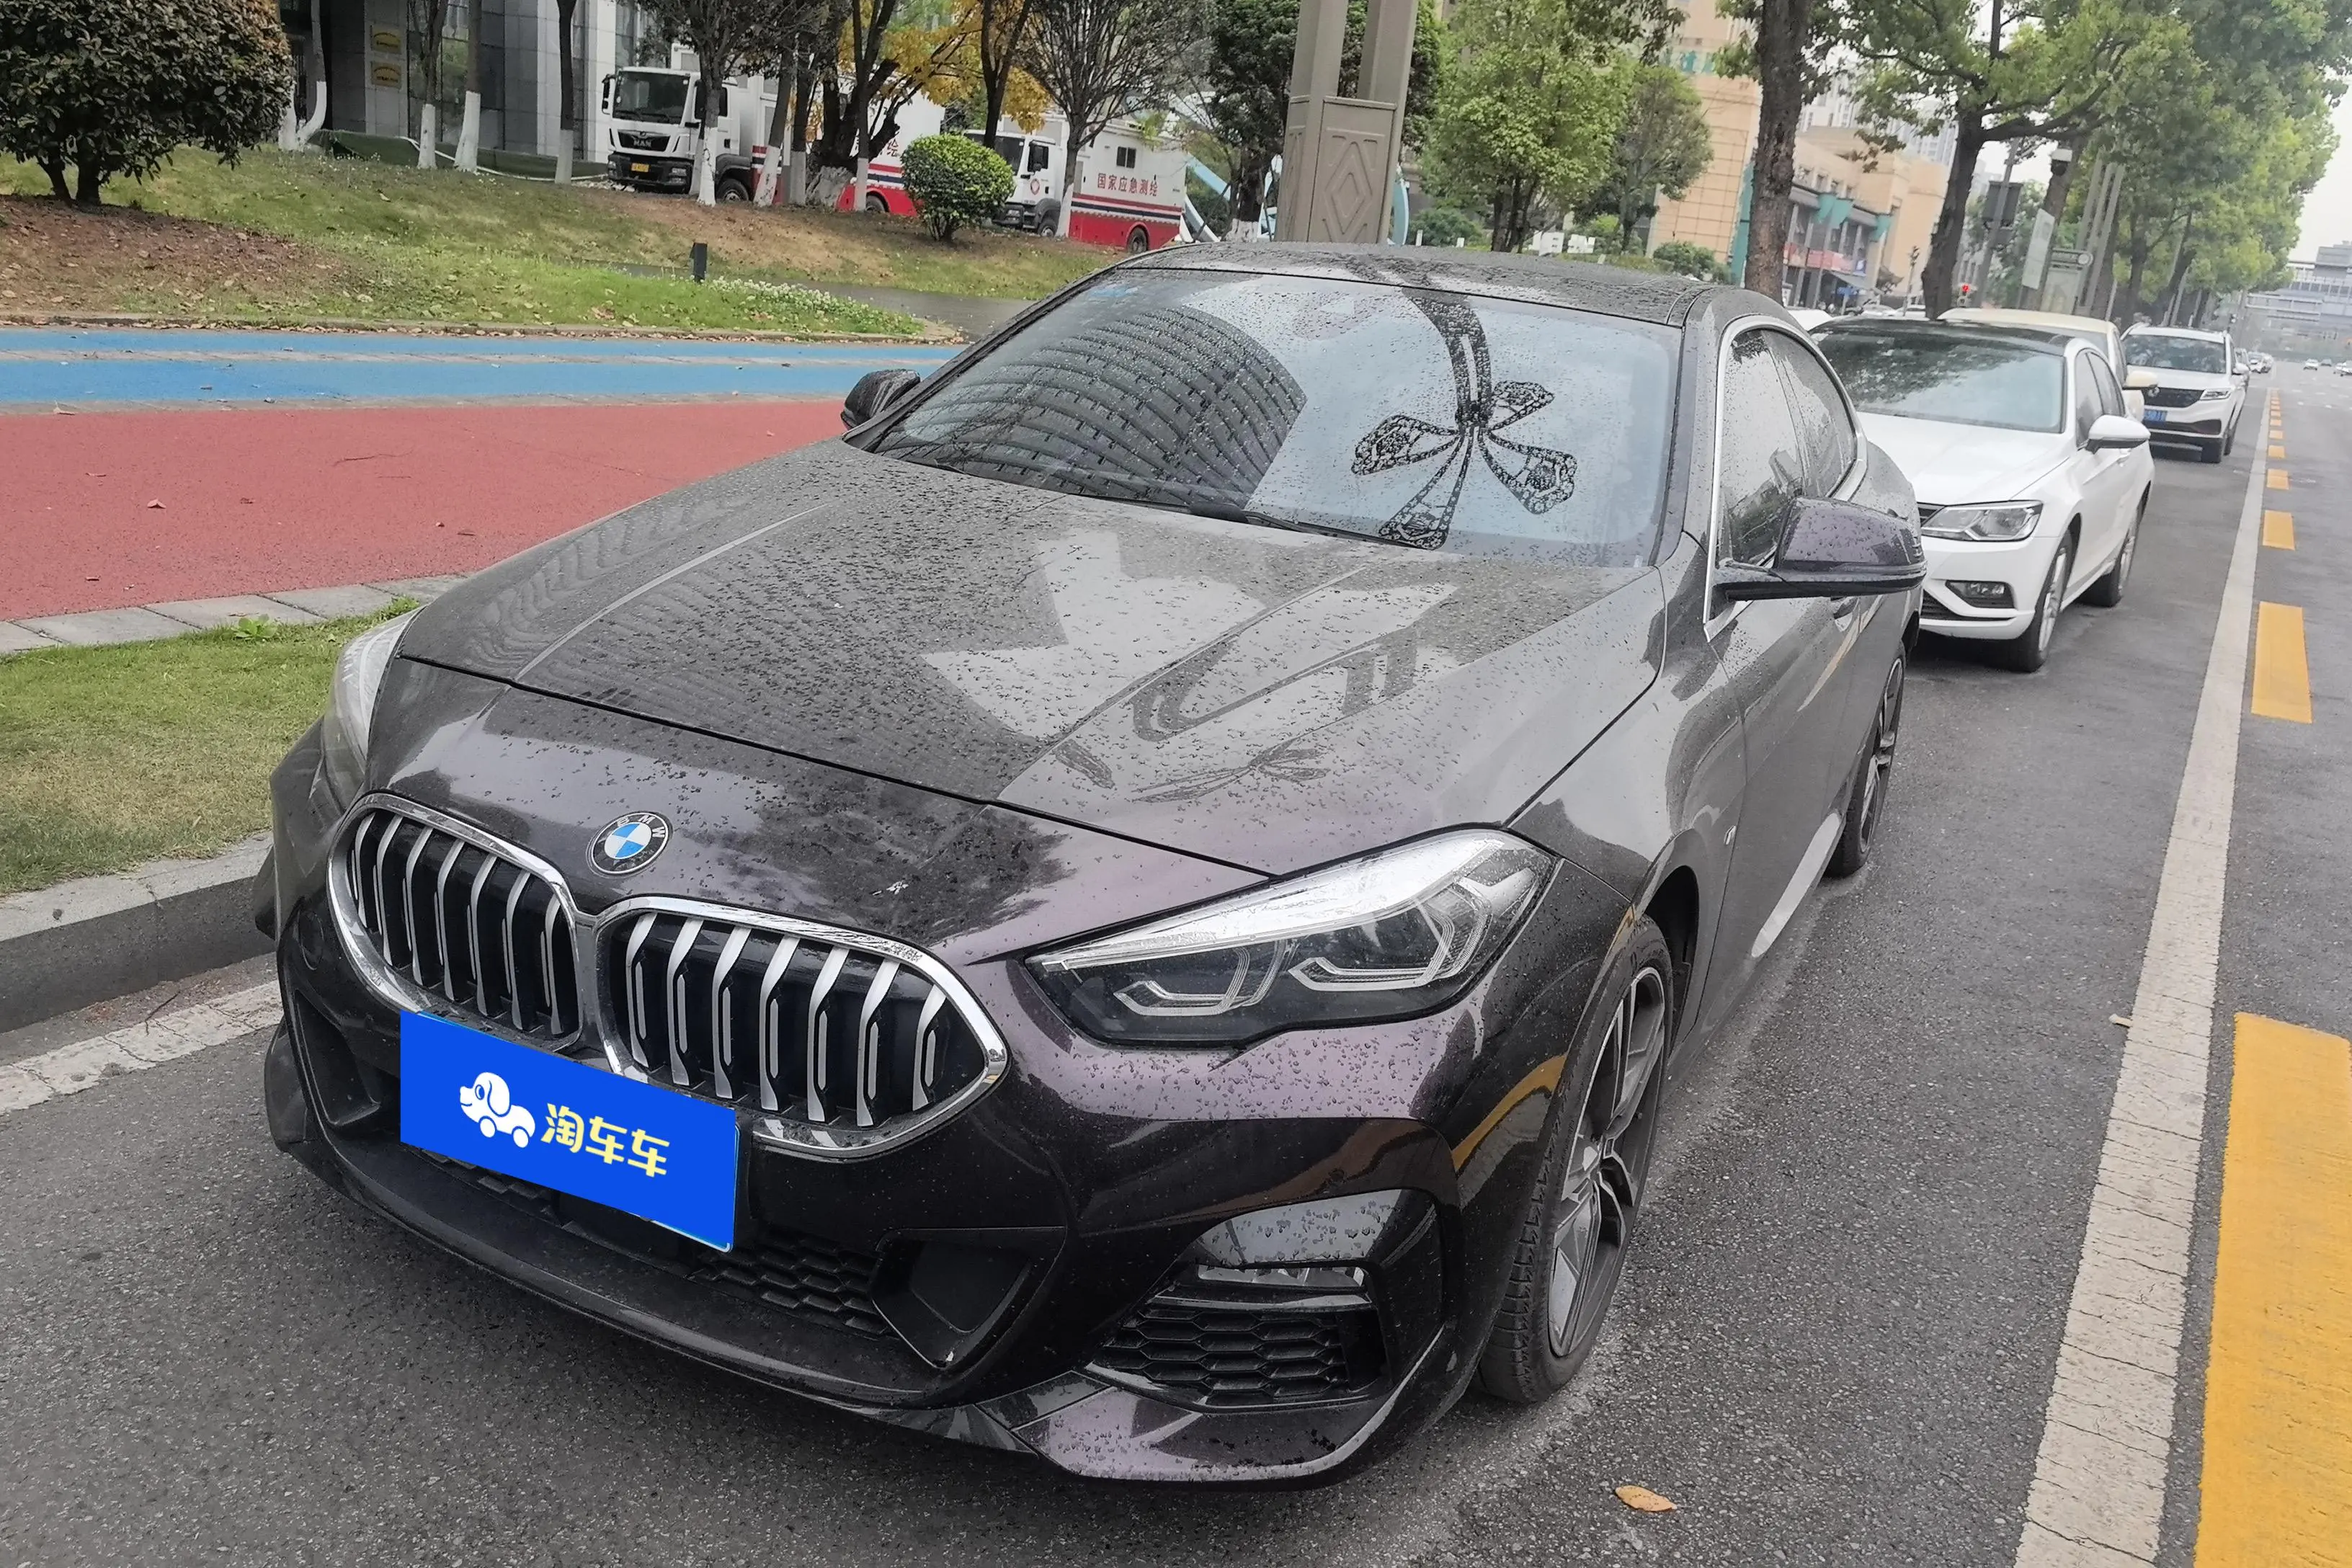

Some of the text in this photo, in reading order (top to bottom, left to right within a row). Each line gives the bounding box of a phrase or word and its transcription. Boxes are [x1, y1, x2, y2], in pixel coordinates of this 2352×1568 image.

[1097, 173, 1157, 196] 国家应急测绘
[616, 814, 665, 838] BMW
